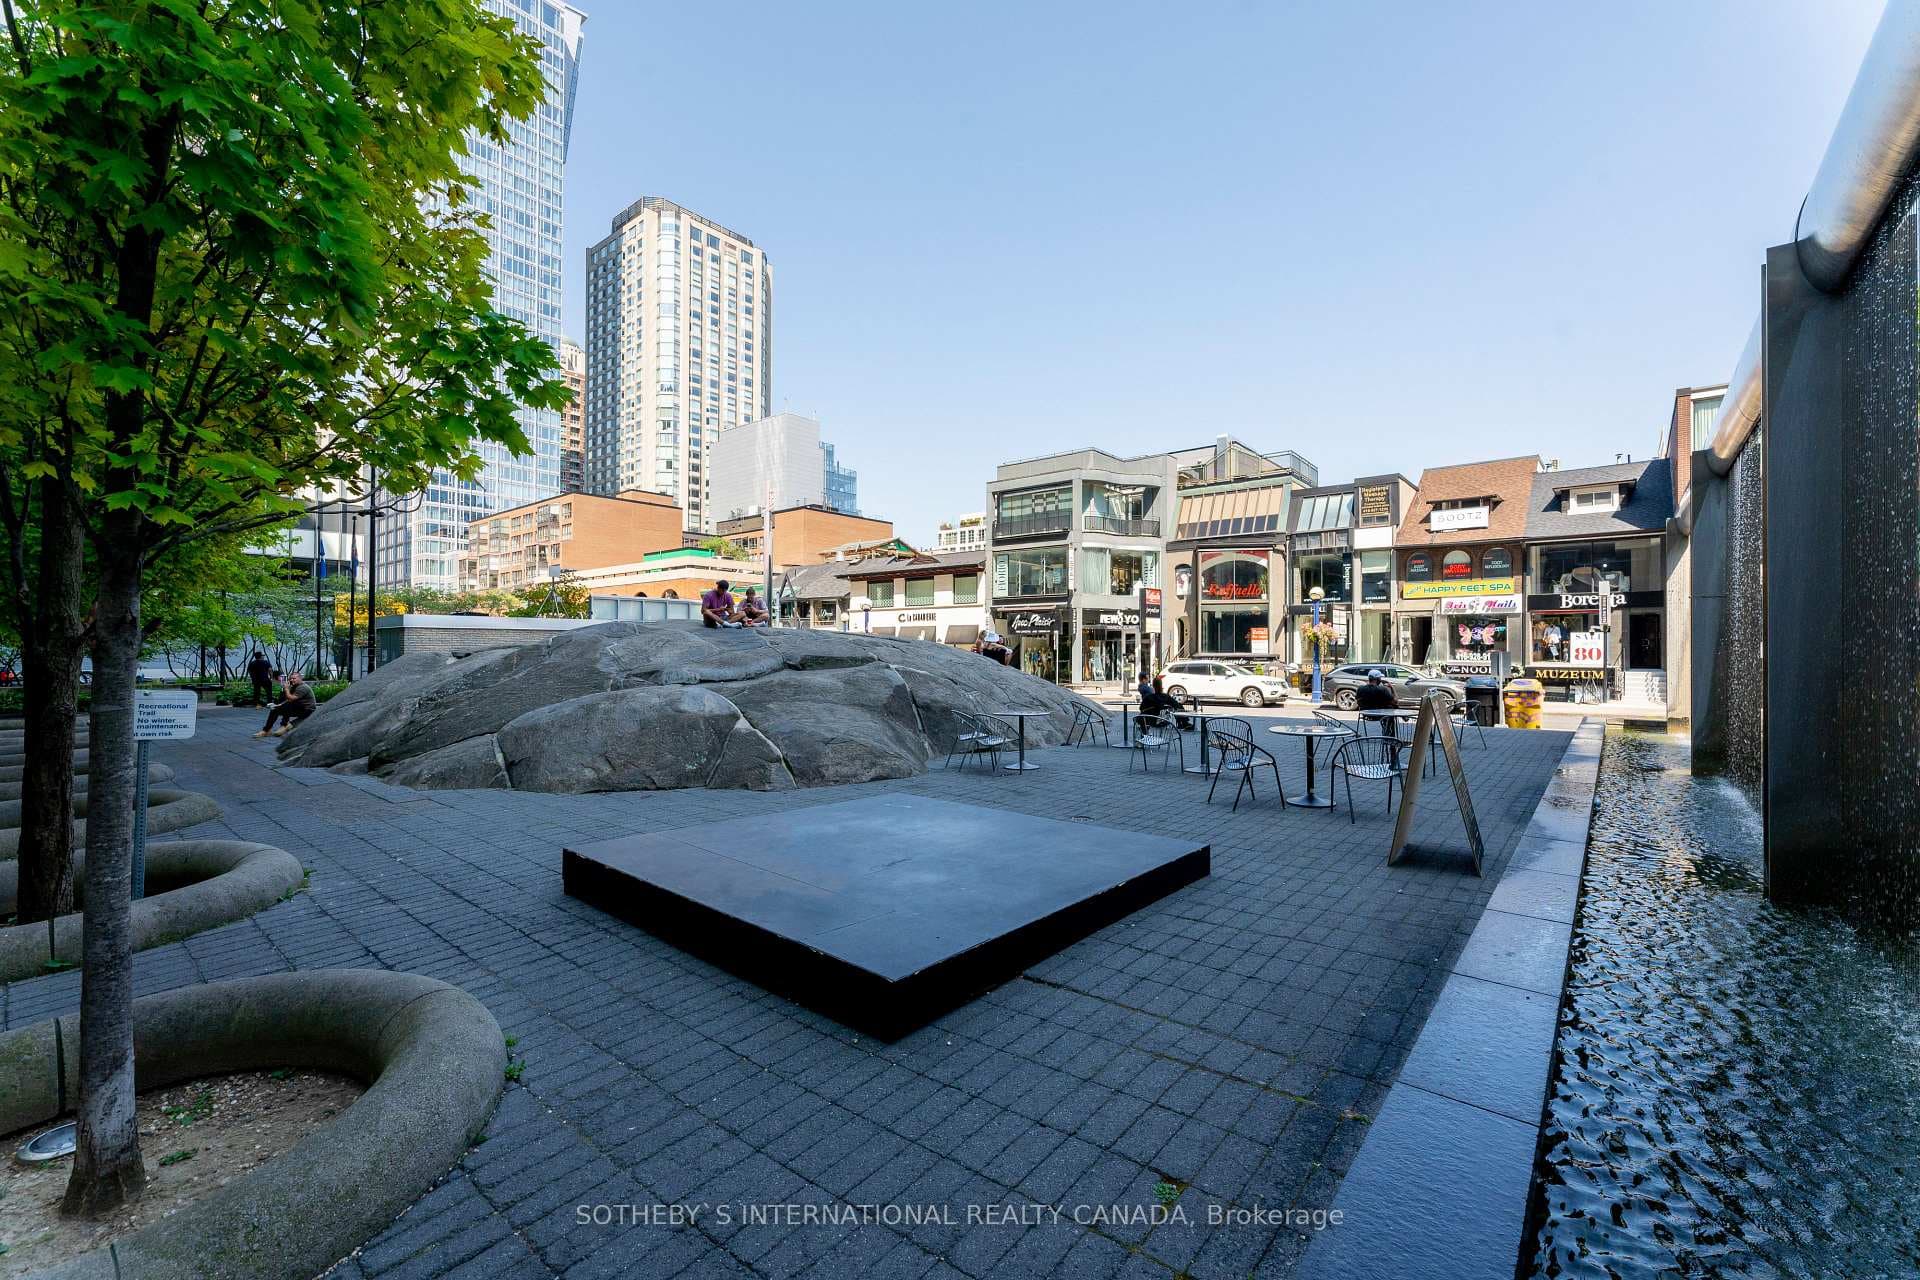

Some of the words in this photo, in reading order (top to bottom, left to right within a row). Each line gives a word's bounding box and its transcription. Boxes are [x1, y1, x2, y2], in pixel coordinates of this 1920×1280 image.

[1423, 585, 1458, 594] HAPPY
[1460, 584, 1487, 592] FEET
[1489, 583, 1512, 591] SPA
[1485, 599, 1517, 609] Nails
[1560, 593, 1627, 608] Boreta
[1011, 614, 1028, 630] Avec
[1574, 647, 1602, 661] 80
[1461, 665, 1492, 674] NOO
[1536, 669, 1604, 680] MUZEUM
